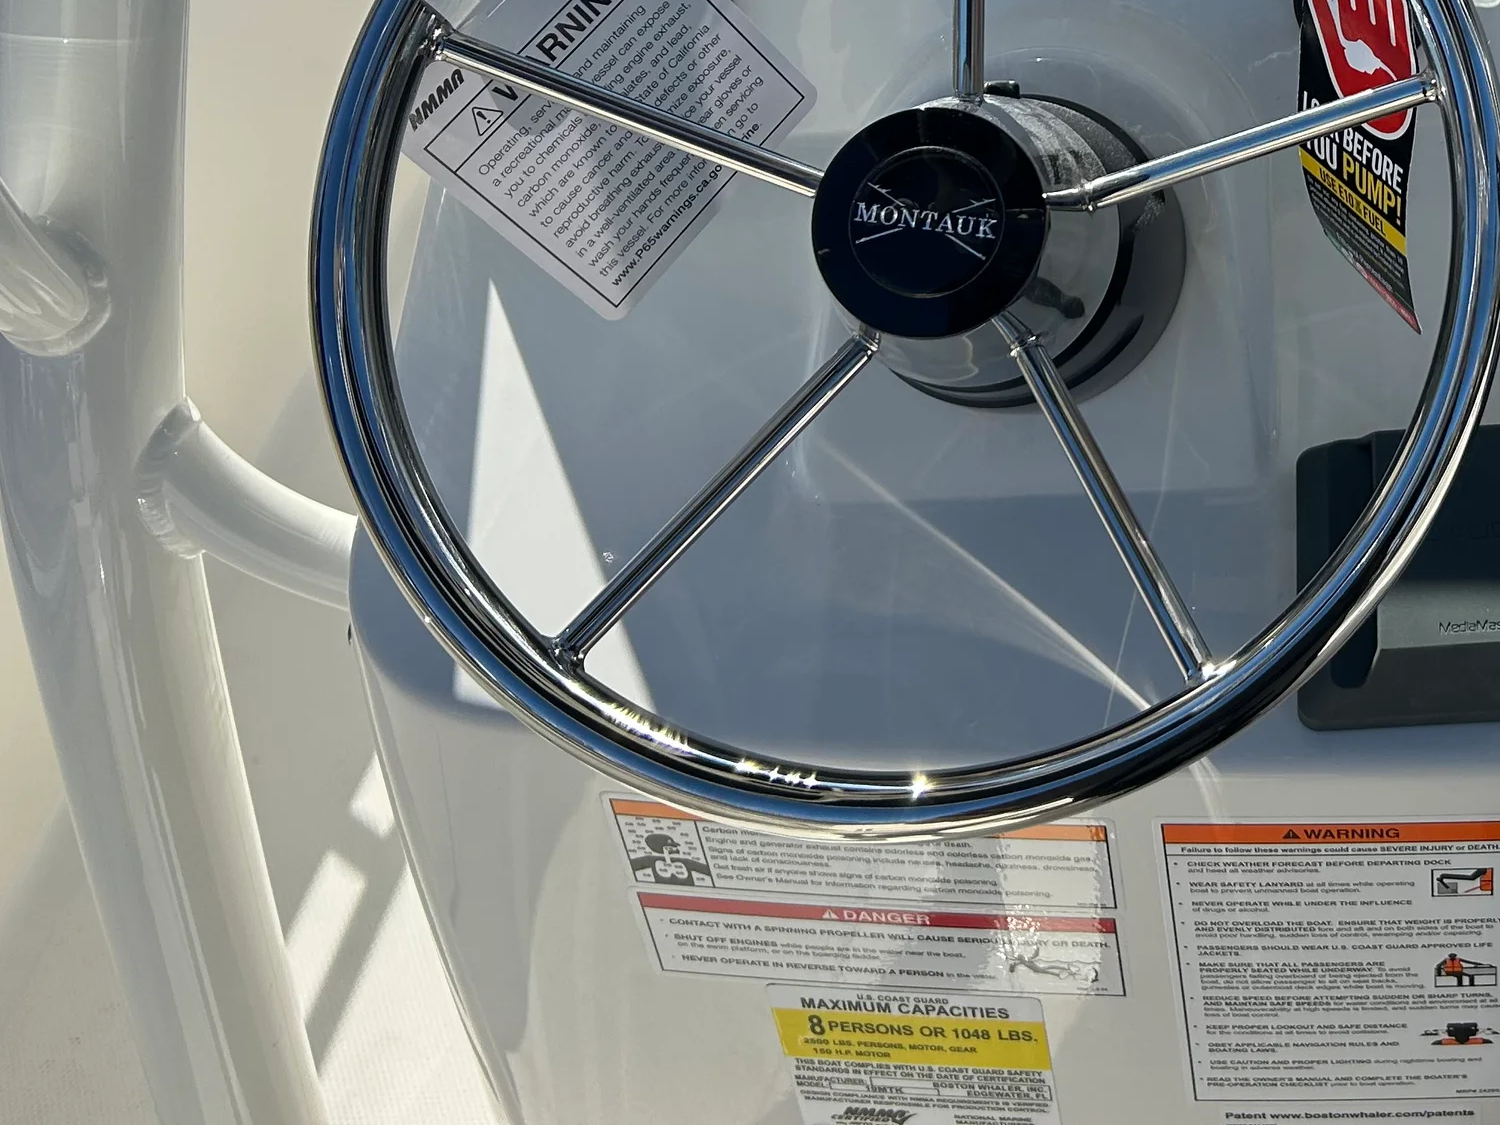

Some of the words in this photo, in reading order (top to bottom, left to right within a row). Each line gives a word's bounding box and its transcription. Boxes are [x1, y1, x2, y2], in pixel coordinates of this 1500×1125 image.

[617, 36, 637, 56] can
[636, 0, 670, 36] expose
[622, 41, 654, 74] engine
[653, 2, 691, 41] exhaust,
[649, 44, 669, 67] and
[666, 23, 692, 48] lead,
[658, 66, 670, 80] of
[667, 24, 710, 68] California
[410, 68, 465, 130] NMMA
[478, 125, 532, 175] Operating,
[591, 4, 646, 60] maintaining
[651, 70, 687, 109] defects
[686, 58, 698, 71] or
[697, 32, 720, 59] other
[687, 48, 731, 92] exposure,
[694, 83, 716, 107] your
[713, 53, 742, 87] vessel
[713, 74, 744, 109] gloves
[741, 64, 752, 77] or
[723, 76, 763, 116] servicing
[734, 113, 748, 130] go
[745, 102, 758, 114] to
[499, 118, 557, 178] recreational
[503, 176, 524, 199] you
[521, 165, 535, 177] to
[535, 116, 583, 165] chemicals
[517, 171, 552, 207] carbon
[550, 116, 601, 172] monoxide,
[528, 186, 559, 217] which
[557, 169, 575, 187] are
[571, 136, 607, 170] known
[604, 122, 617, 136] to
[1343, 127, 1403, 194] BEFORE
[539, 215, 553, 227] to
[552, 184, 582, 215] cause
[581, 149, 613, 184] cancer
[553, 177, 610, 238] reproductive
[607, 150, 637, 177] harm.
[574, 246, 588, 258] in
[593, 170, 655, 238] well-ventilated
[654, 150, 676, 172] area
[1306, 134, 1337, 171] OU
[1343, 151, 1401, 226] PUMP!
[1319, 167, 1335, 188] USE
[1339, 185, 1356, 206] E10
[1362, 208, 1385, 234] FUEL
[565, 218, 590, 248] avoid
[587, 176, 632, 221] breathing
[587, 240, 614, 266] wash
[612, 216, 633, 242] your
[630, 187, 662, 218] hands
[599, 257, 618, 276] this
[616, 224, 649, 257] vessel.
[646, 204, 664, 224] For
[663, 179, 688, 206] more
[854, 201, 998, 239] MONTAUK
[1304, 828, 1400, 840] WARNING
[843, 909, 930, 925] DANGER
[800, 997, 891, 1013] MAXIMUM
[898, 1003, 1010, 1019] CAPACITIES
[808, 1015, 826, 1036] 8
[828, 1020, 914, 1036] PERSONS
[920, 1025, 947, 1038] OR
[952, 1028, 991, 1040] 1048
[998, 1029, 1039, 1042] LBS.
[857, 993, 876, 1001] U.S.
[877, 995, 911, 1003] COAST
[914, 997, 949, 1005] GUARD
[1225, 1111, 1266, 1120] Patent
[1269, 1108, 1475, 1120] www.bostonwhaler.com/patents
